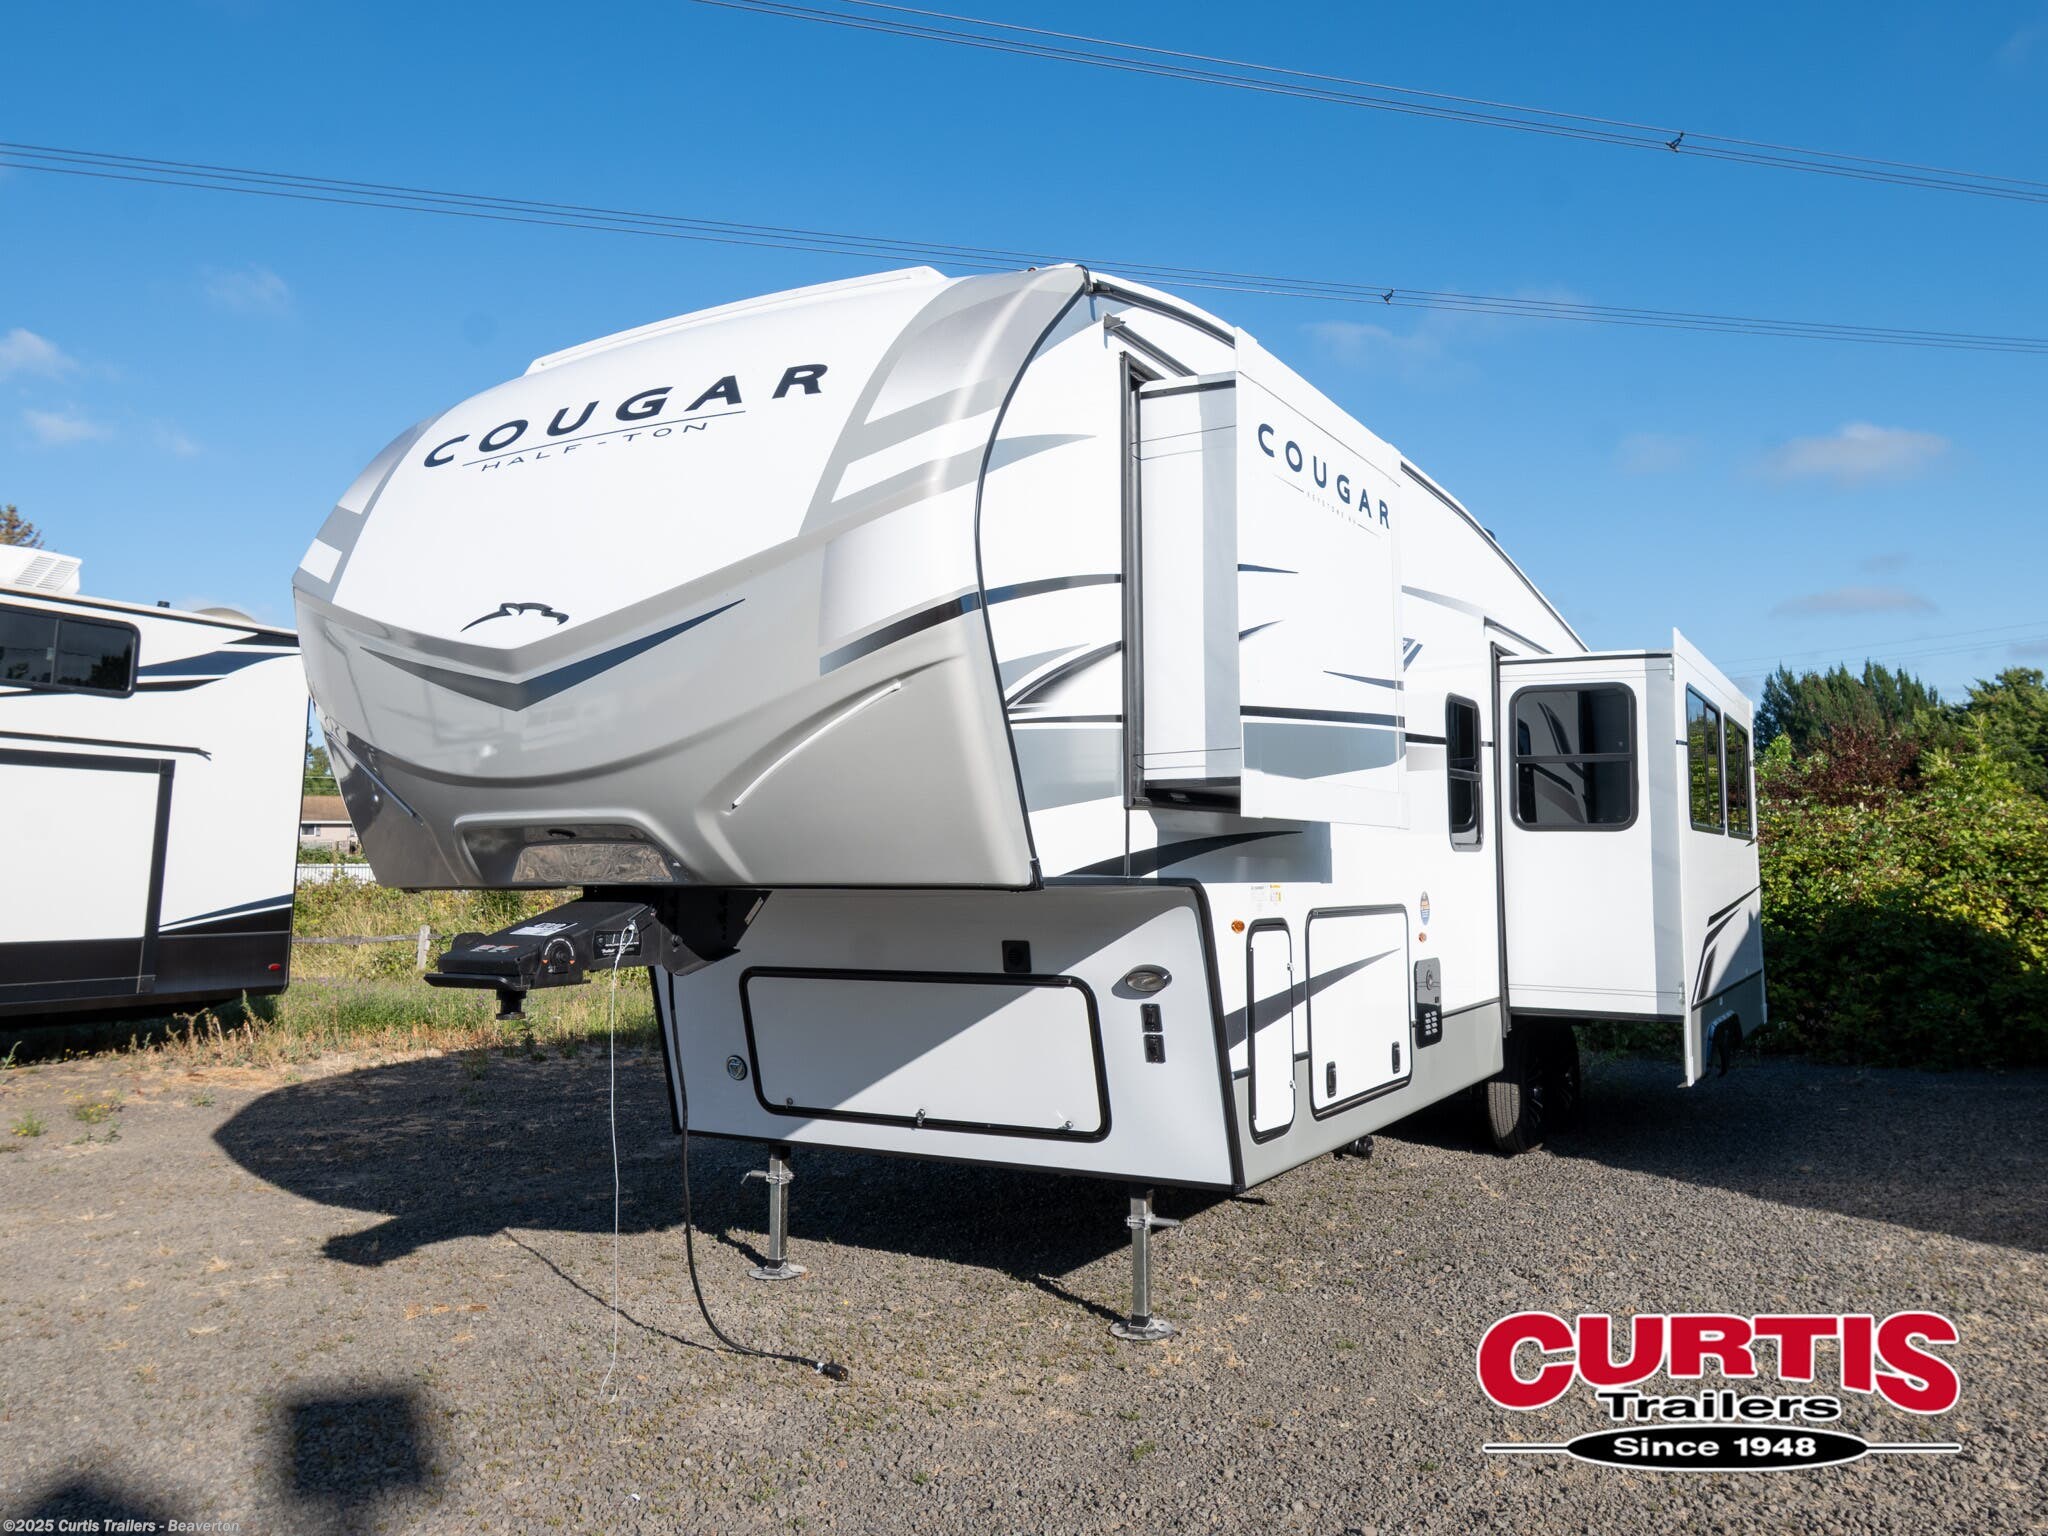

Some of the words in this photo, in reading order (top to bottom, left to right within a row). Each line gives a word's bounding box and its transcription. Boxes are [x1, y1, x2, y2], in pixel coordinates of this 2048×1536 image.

[423, 364, 828, 468] COUGAR
[481, 422, 709, 472] HALF-TON
[1258, 423, 1390, 530] COUGAR
